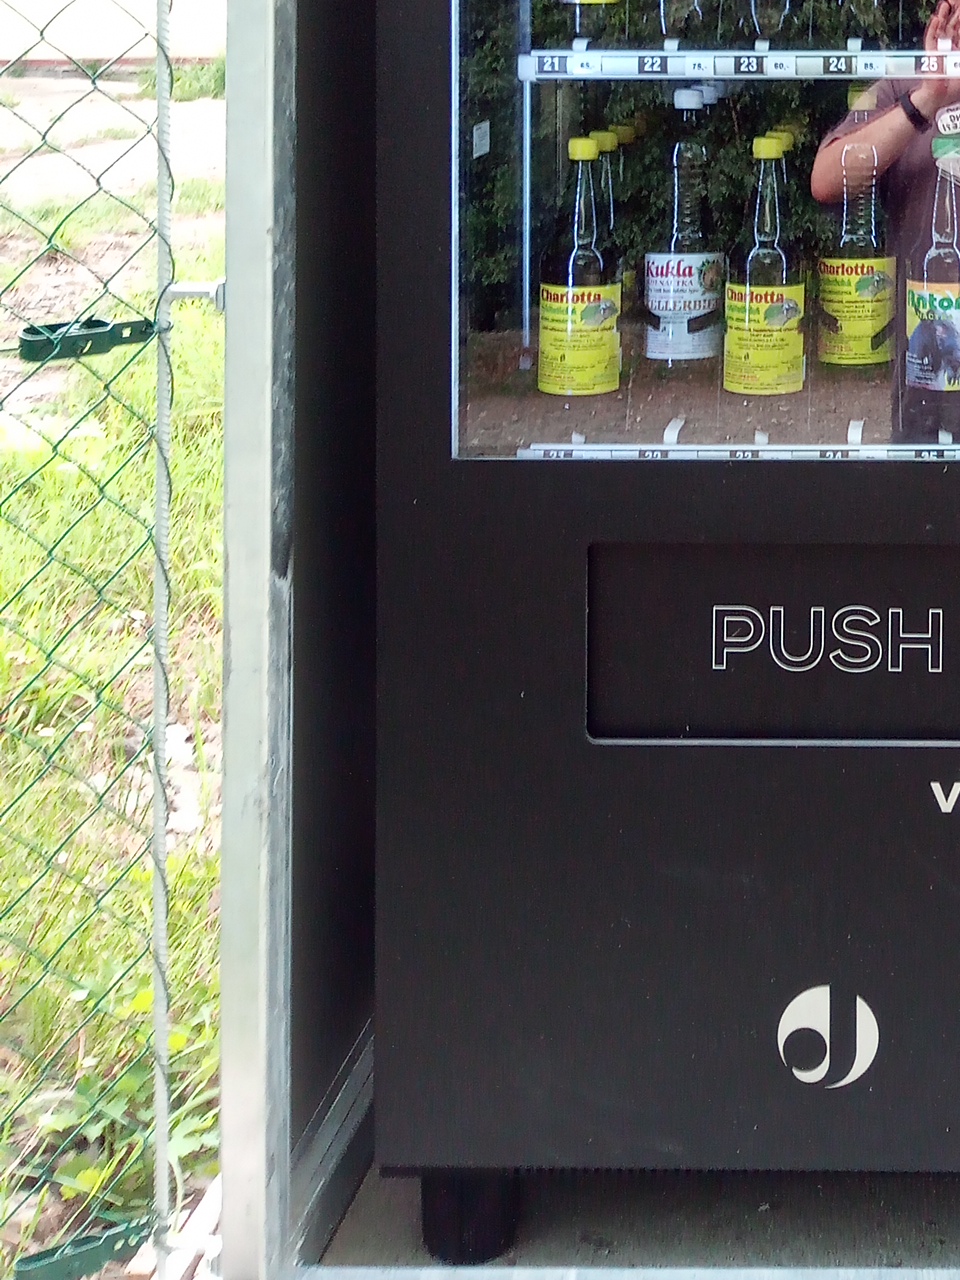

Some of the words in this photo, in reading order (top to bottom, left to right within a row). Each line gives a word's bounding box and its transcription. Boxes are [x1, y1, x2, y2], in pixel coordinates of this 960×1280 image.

[543, 56, 560, 72] 21
[643, 56, 662, 72] 22
[740, 56, 758, 72] 23
[829, 56, 847, 72] 24
[920, 56, 938, 72] 25
[646, 259, 695, 279] Kukla
[711, 604, 944, 673] PUSH
